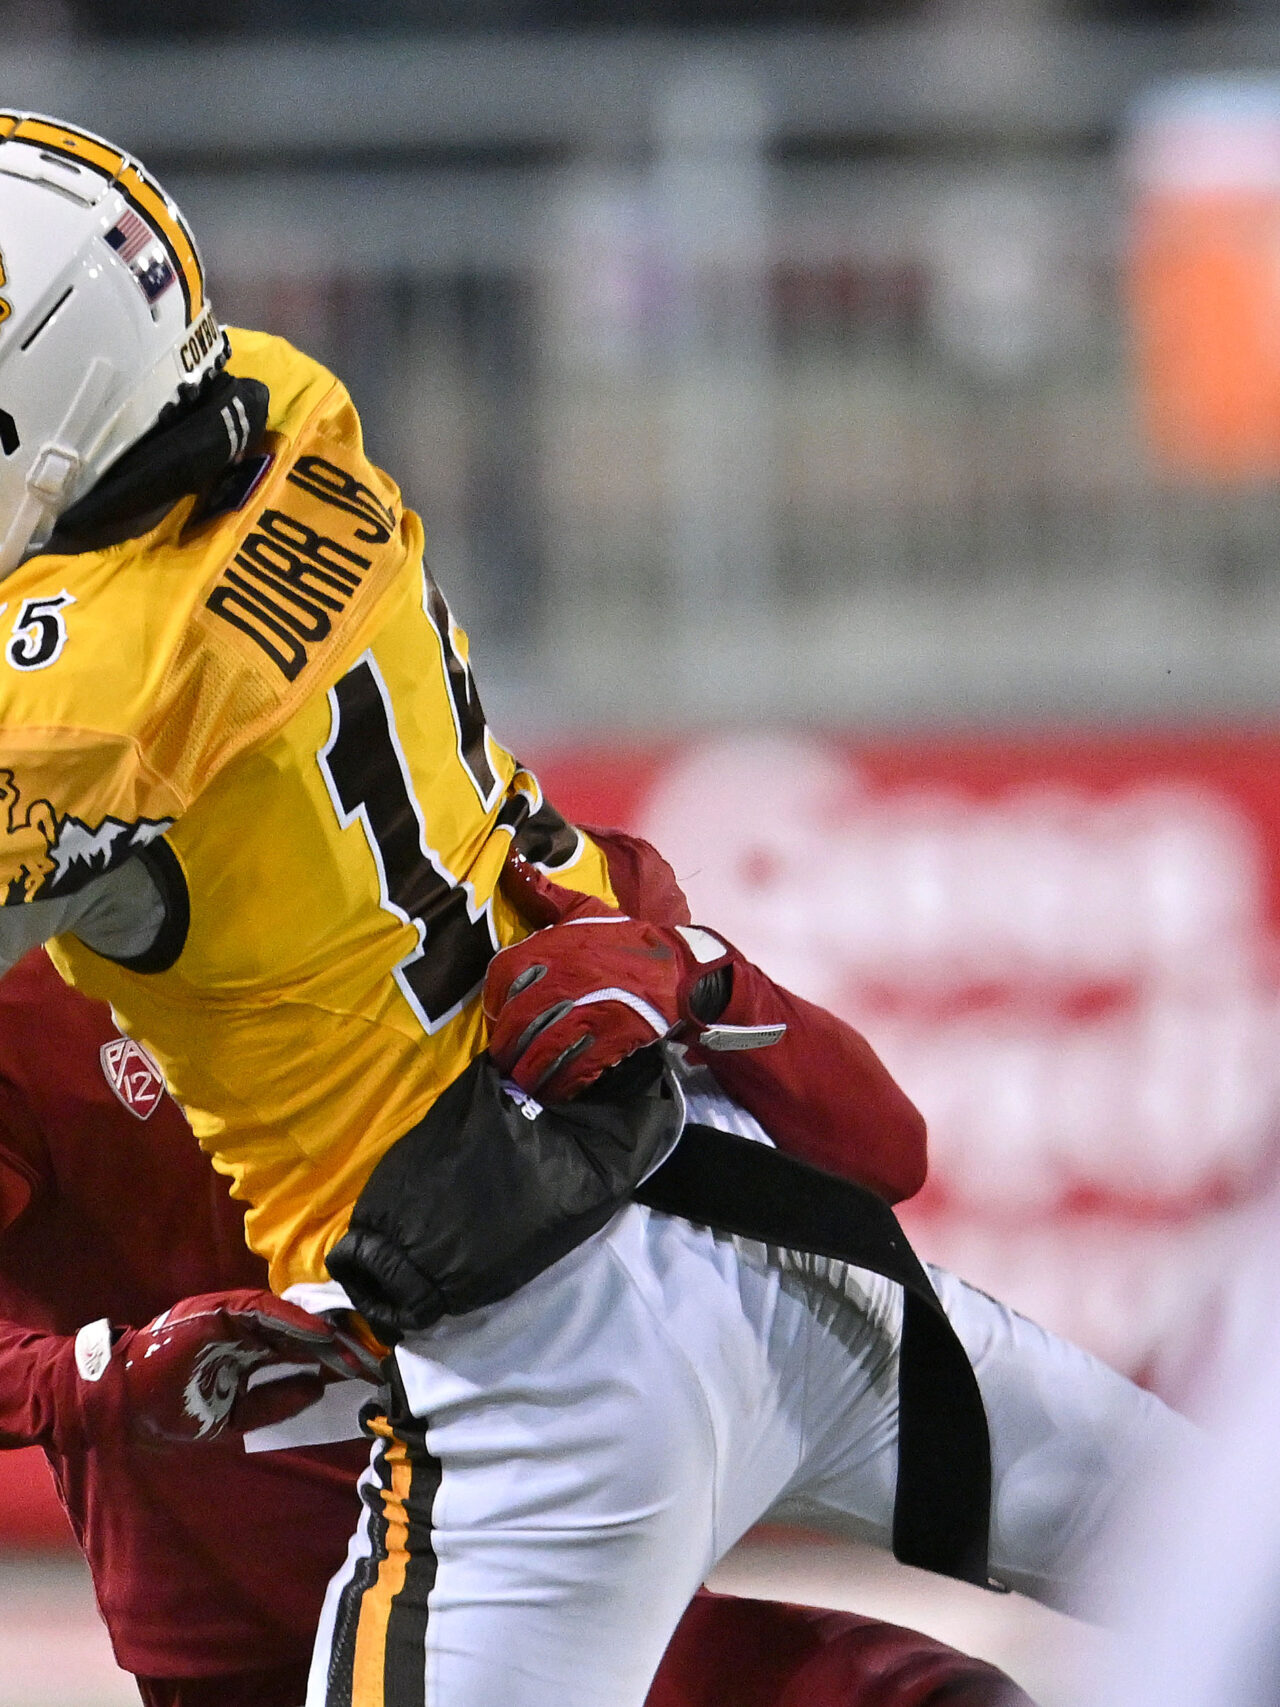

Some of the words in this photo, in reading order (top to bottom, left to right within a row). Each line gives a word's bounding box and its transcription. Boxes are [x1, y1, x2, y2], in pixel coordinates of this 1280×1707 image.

[205, 509, 373, 682] DURR
[105, 1039, 163, 1090] PA
[124, 1071, 156, 1104] 12
